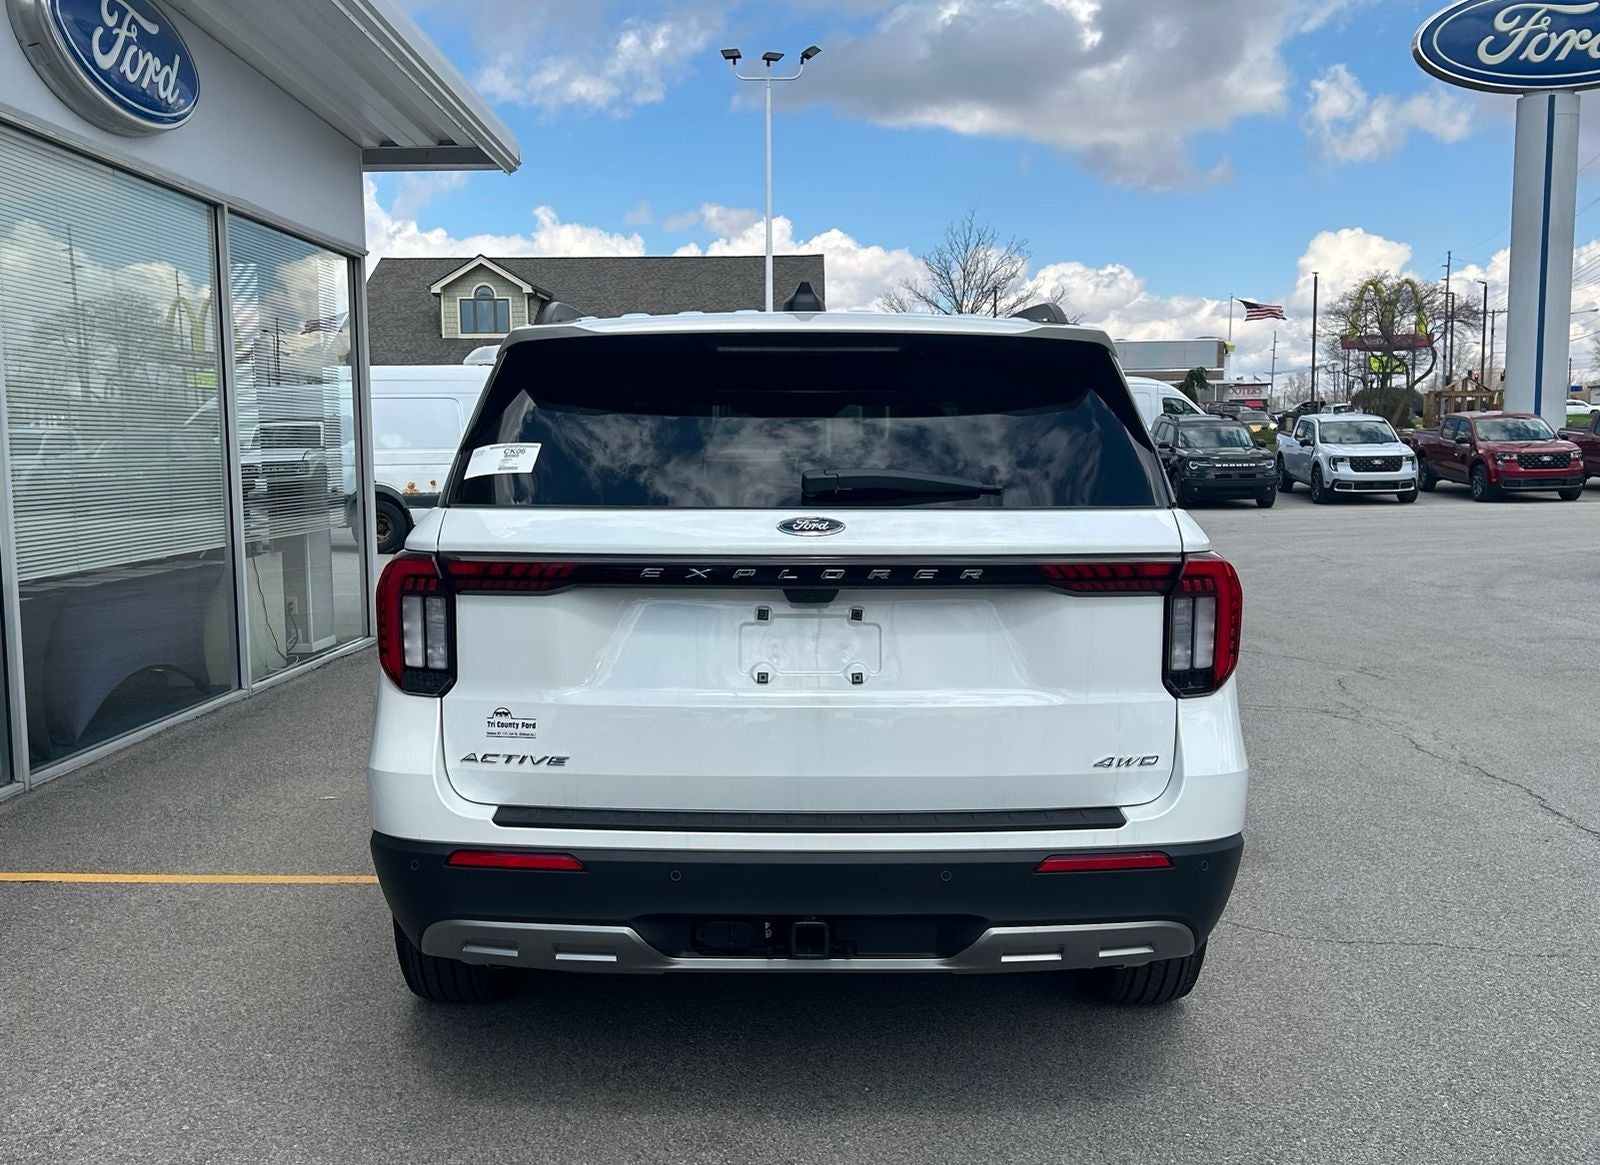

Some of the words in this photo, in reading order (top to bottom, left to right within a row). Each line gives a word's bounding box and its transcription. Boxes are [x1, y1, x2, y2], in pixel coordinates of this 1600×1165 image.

[92, 0, 181, 104] Ford
[792, 519, 830, 530] Ford
[640, 567, 984, 580] EXPLORER
[497, 721, 519, 730] County
[460, 752, 570, 767] ACTIVE
[1093, 755, 1159, 768] 4WD
